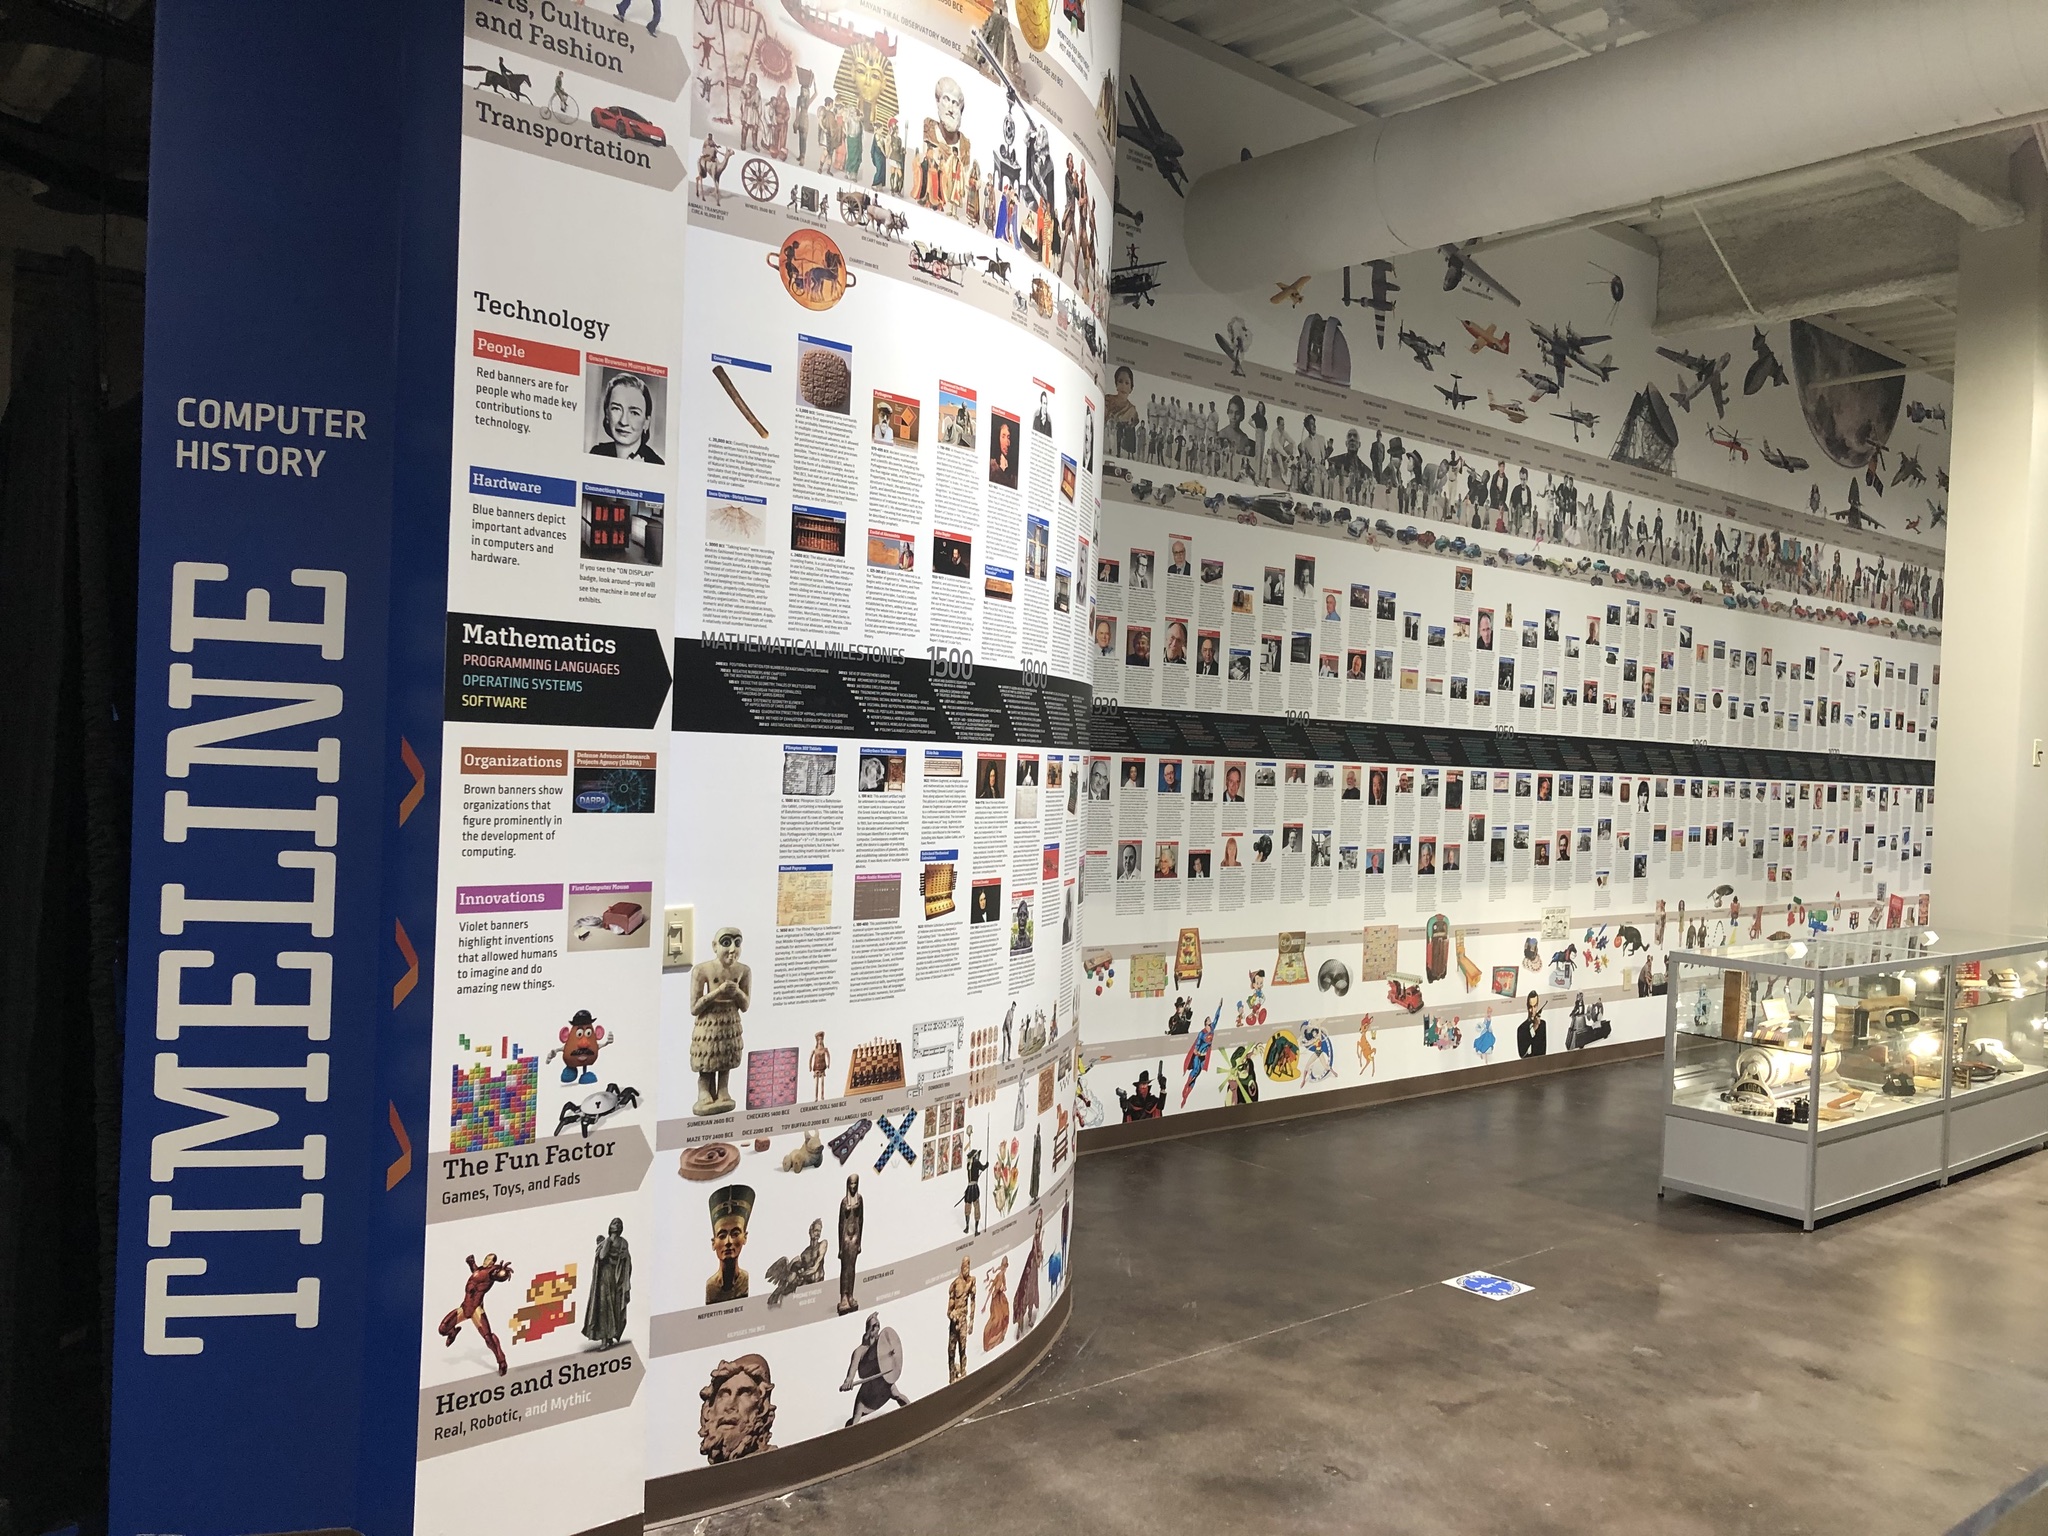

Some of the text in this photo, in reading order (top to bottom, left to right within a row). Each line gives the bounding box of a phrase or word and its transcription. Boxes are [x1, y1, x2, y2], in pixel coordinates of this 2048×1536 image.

[953, 1, 963, 13] BCE
[488, 0, 635, 53] ts, Culture,
[860, 1, 961, 52] MAYAN TIKAL OBSERVATORY 1000 BCE
[476, 10, 623, 73] and Fashion
[476, 100, 651, 169] Transportation
[704, 206, 728, 216] TRANSPORT
[474, 290, 610, 341] Technology
[478, 338, 525, 357] People
[476, 367, 568, 393] Red banners are for
[476, 384, 577, 411] people who made key
[177, 397, 367, 440] COMPUTER
[476, 400, 552, 420] contributions to
[475, 415, 530, 434] technology.
[176, 440, 326, 478] HISTORY
[473, 473, 542, 494] Hardware
[585, 484, 615, 494] Connection
[616, 489, 638, 497] Machine
[473, 504, 566, 525] Blue banners depict
[472, 520, 567, 540] important advances
[472, 535, 553, 554] in computers and
[471, 551, 520, 566] hardware.
[580, 574, 598, 583] badge,
[462, 623, 616, 654] Mathematics
[701, 631, 906, 666] MATHEMATICAL MILESTONES
[463, 654, 620, 675] PROGRAMMING LANGUAGES
[927, 646, 973, 680] 1500
[1020, 658, 1047, 689] 1800
[463, 675, 583, 692] OPERATING SYSTEMS
[462, 695, 527, 709] SOFTWARE
[1091, 697, 1118, 716] 1930
[1285, 710, 1310, 727] 1940
[1495, 725, 1514, 739] 1950
[464, 754, 562, 769] Organizations
[464, 784, 563, 795] Brown banners show
[463, 800, 551, 812] organizations that
[463, 816, 562, 827] figure prominently in
[462, 830, 555, 843] the development of
[462, 846, 516, 858] computing.
[460, 891, 545, 906] Innovations
[459, 920, 528, 932] Violet banners
[458, 933, 553, 948] highlight inventions
[144, 561, 348, 1357] TIMELINE
[458, 949, 558, 964] that allowed humans
[458, 964, 542, 980] to imagine and do
[457, 979, 555, 995] amazing new things.
[687, 1120, 712, 1128] SUMERIAN
[747, 1112, 770, 1120] CHECKERS
[443, 1141, 616, 1180] The Fun Factor
[442, 1173, 580, 1205] Games, Toys, and Fads
[698, 1311, 723, 1320] NEFERTITI
[436, 1356, 632, 1416] Heros and Sheros
[435, 1390, 592, 1441] Real, Robotic, and Mythic
